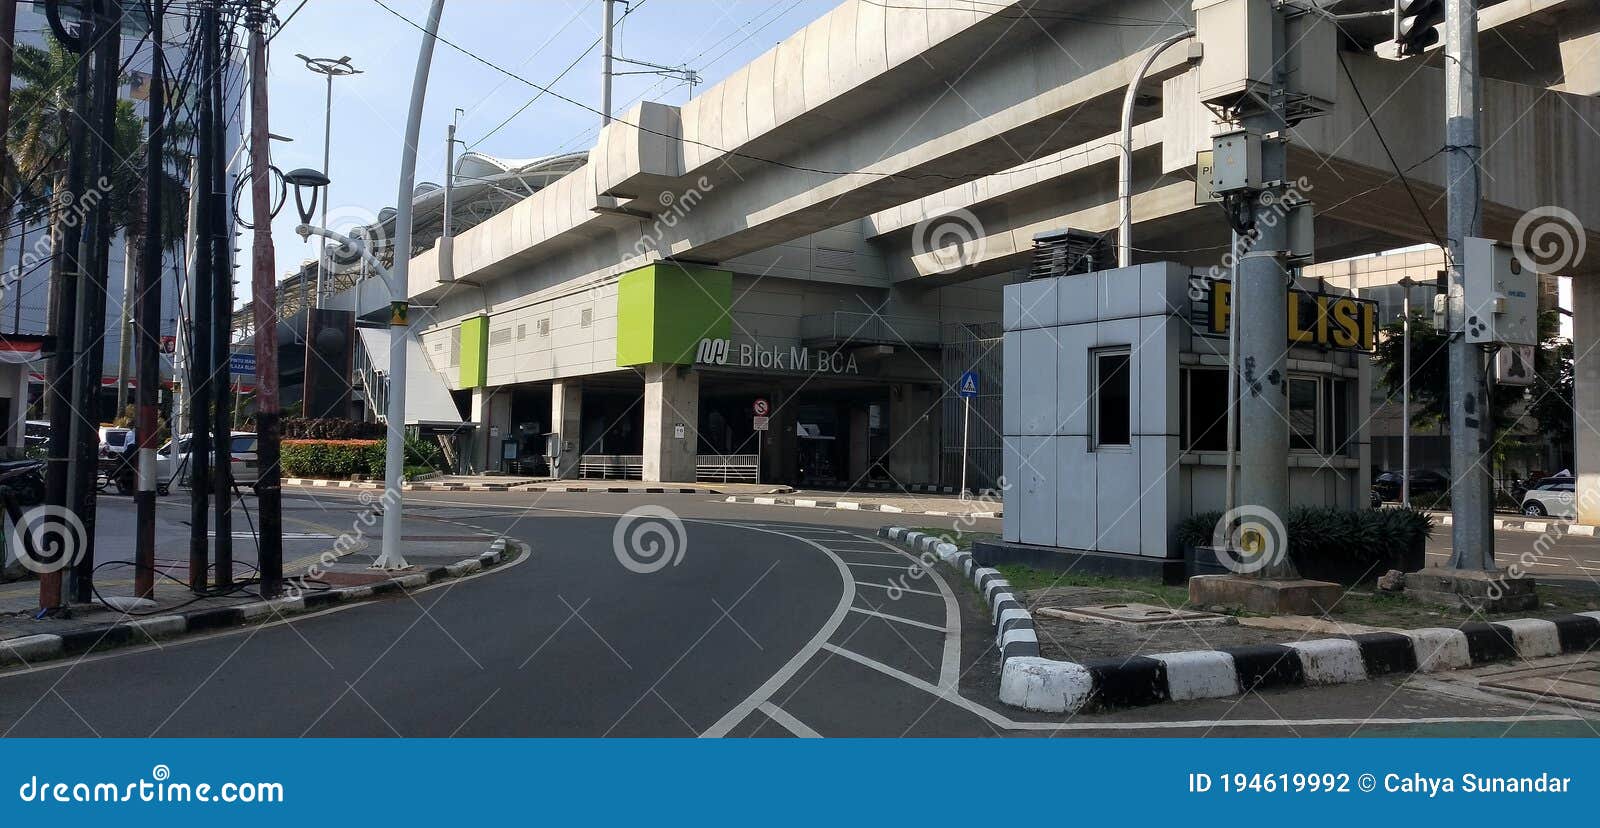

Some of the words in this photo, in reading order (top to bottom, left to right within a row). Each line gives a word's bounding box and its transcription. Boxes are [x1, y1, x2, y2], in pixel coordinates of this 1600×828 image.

[1213, 282, 1374, 351] PLISI
[740, 342, 784, 369] Blok
[790, 346, 808, 371] M
[818, 350, 859, 375] BCA
